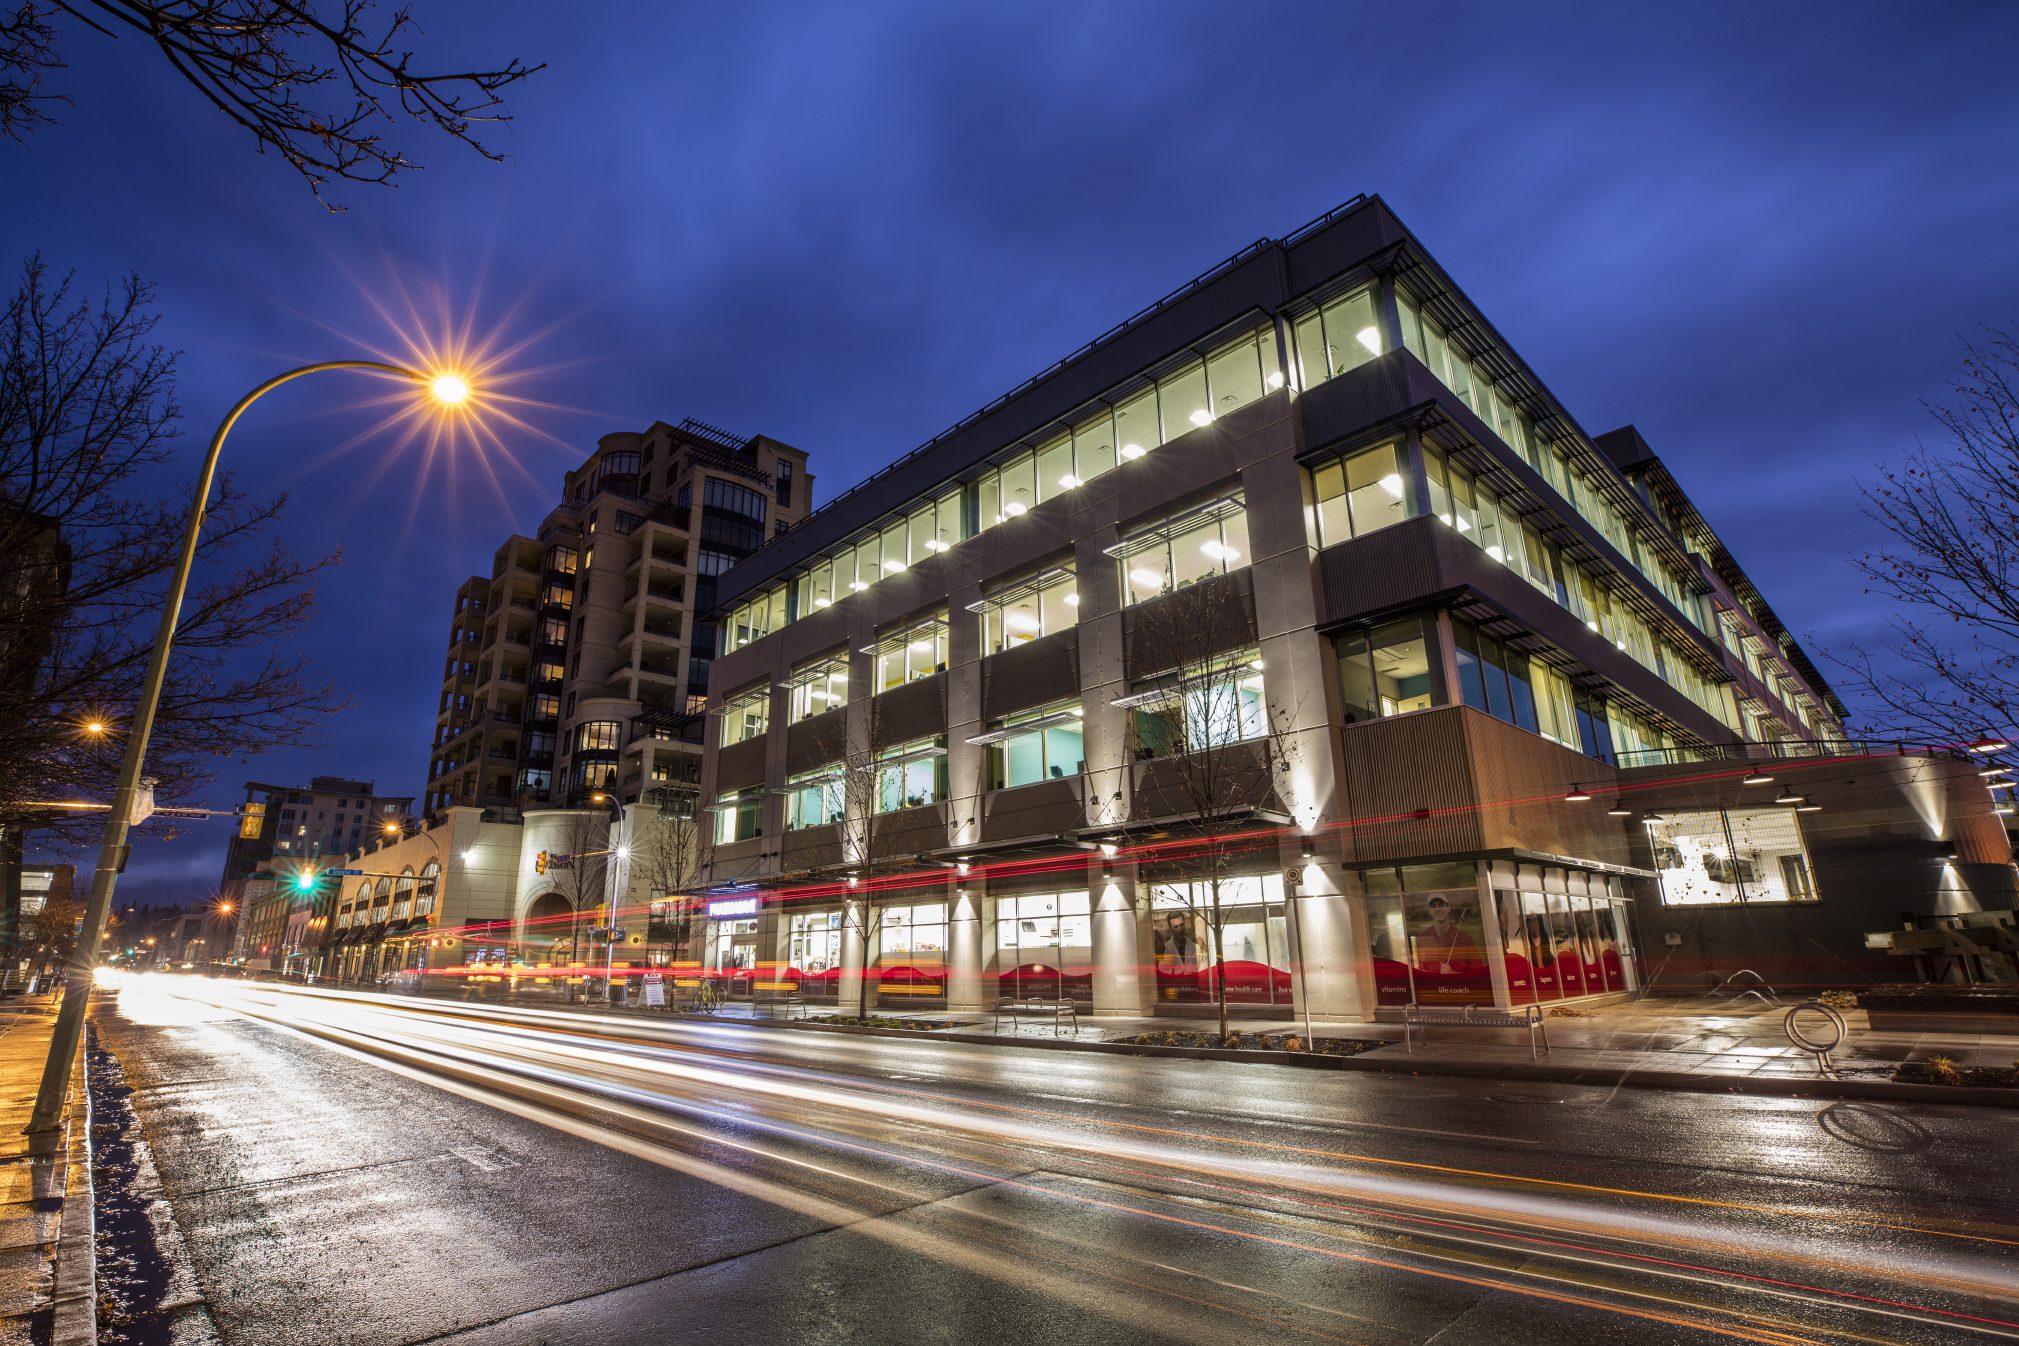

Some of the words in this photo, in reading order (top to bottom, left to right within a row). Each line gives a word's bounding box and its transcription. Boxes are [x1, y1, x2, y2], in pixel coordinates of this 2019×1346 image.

[1235, 985, 1251, 993] health
[1381, 985, 1407, 993] vitamins
[1438, 985, 1449, 994] life
[1449, 986, 1470, 994] coach
